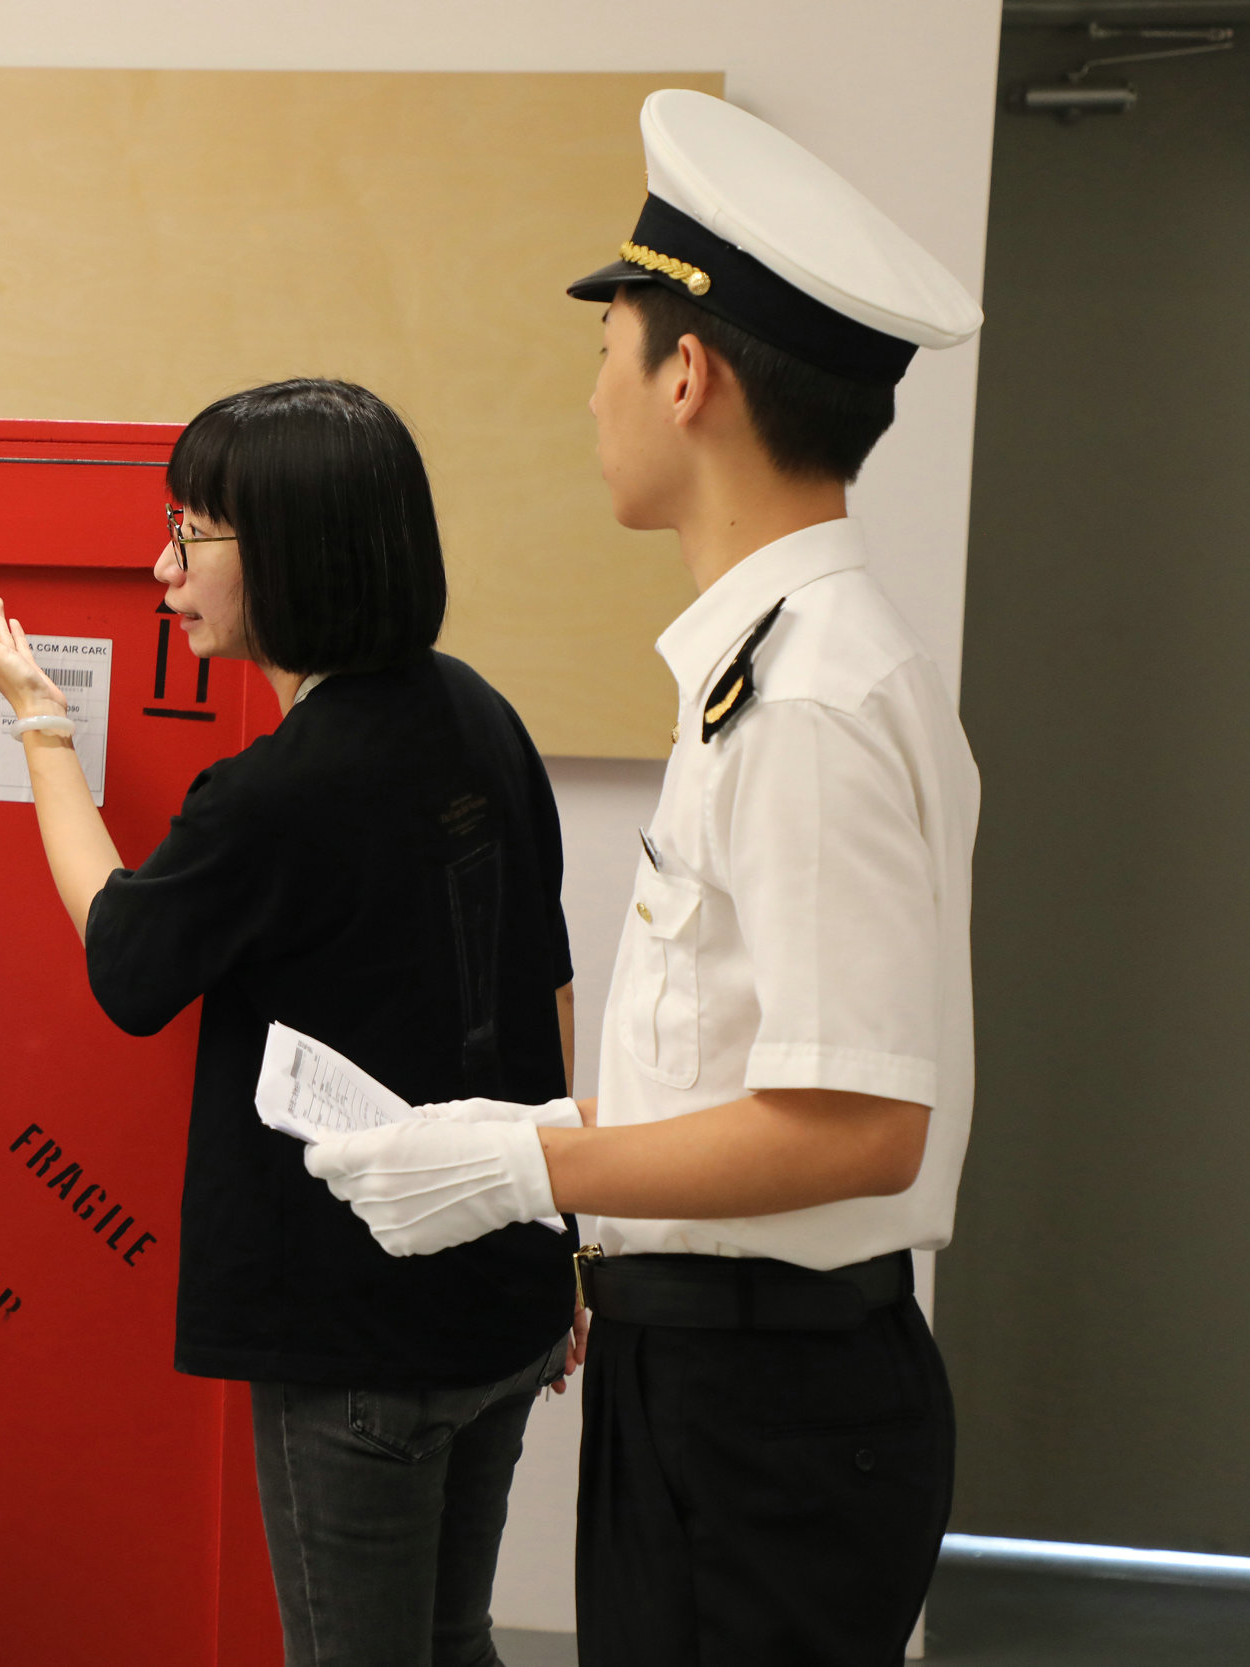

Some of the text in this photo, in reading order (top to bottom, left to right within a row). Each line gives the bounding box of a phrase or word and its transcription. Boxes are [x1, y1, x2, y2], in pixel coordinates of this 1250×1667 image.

[37, 643, 60, 653] CGM
[62, 645, 79, 654] AIR
[9, 1123, 157, 1267] FRAGILE
